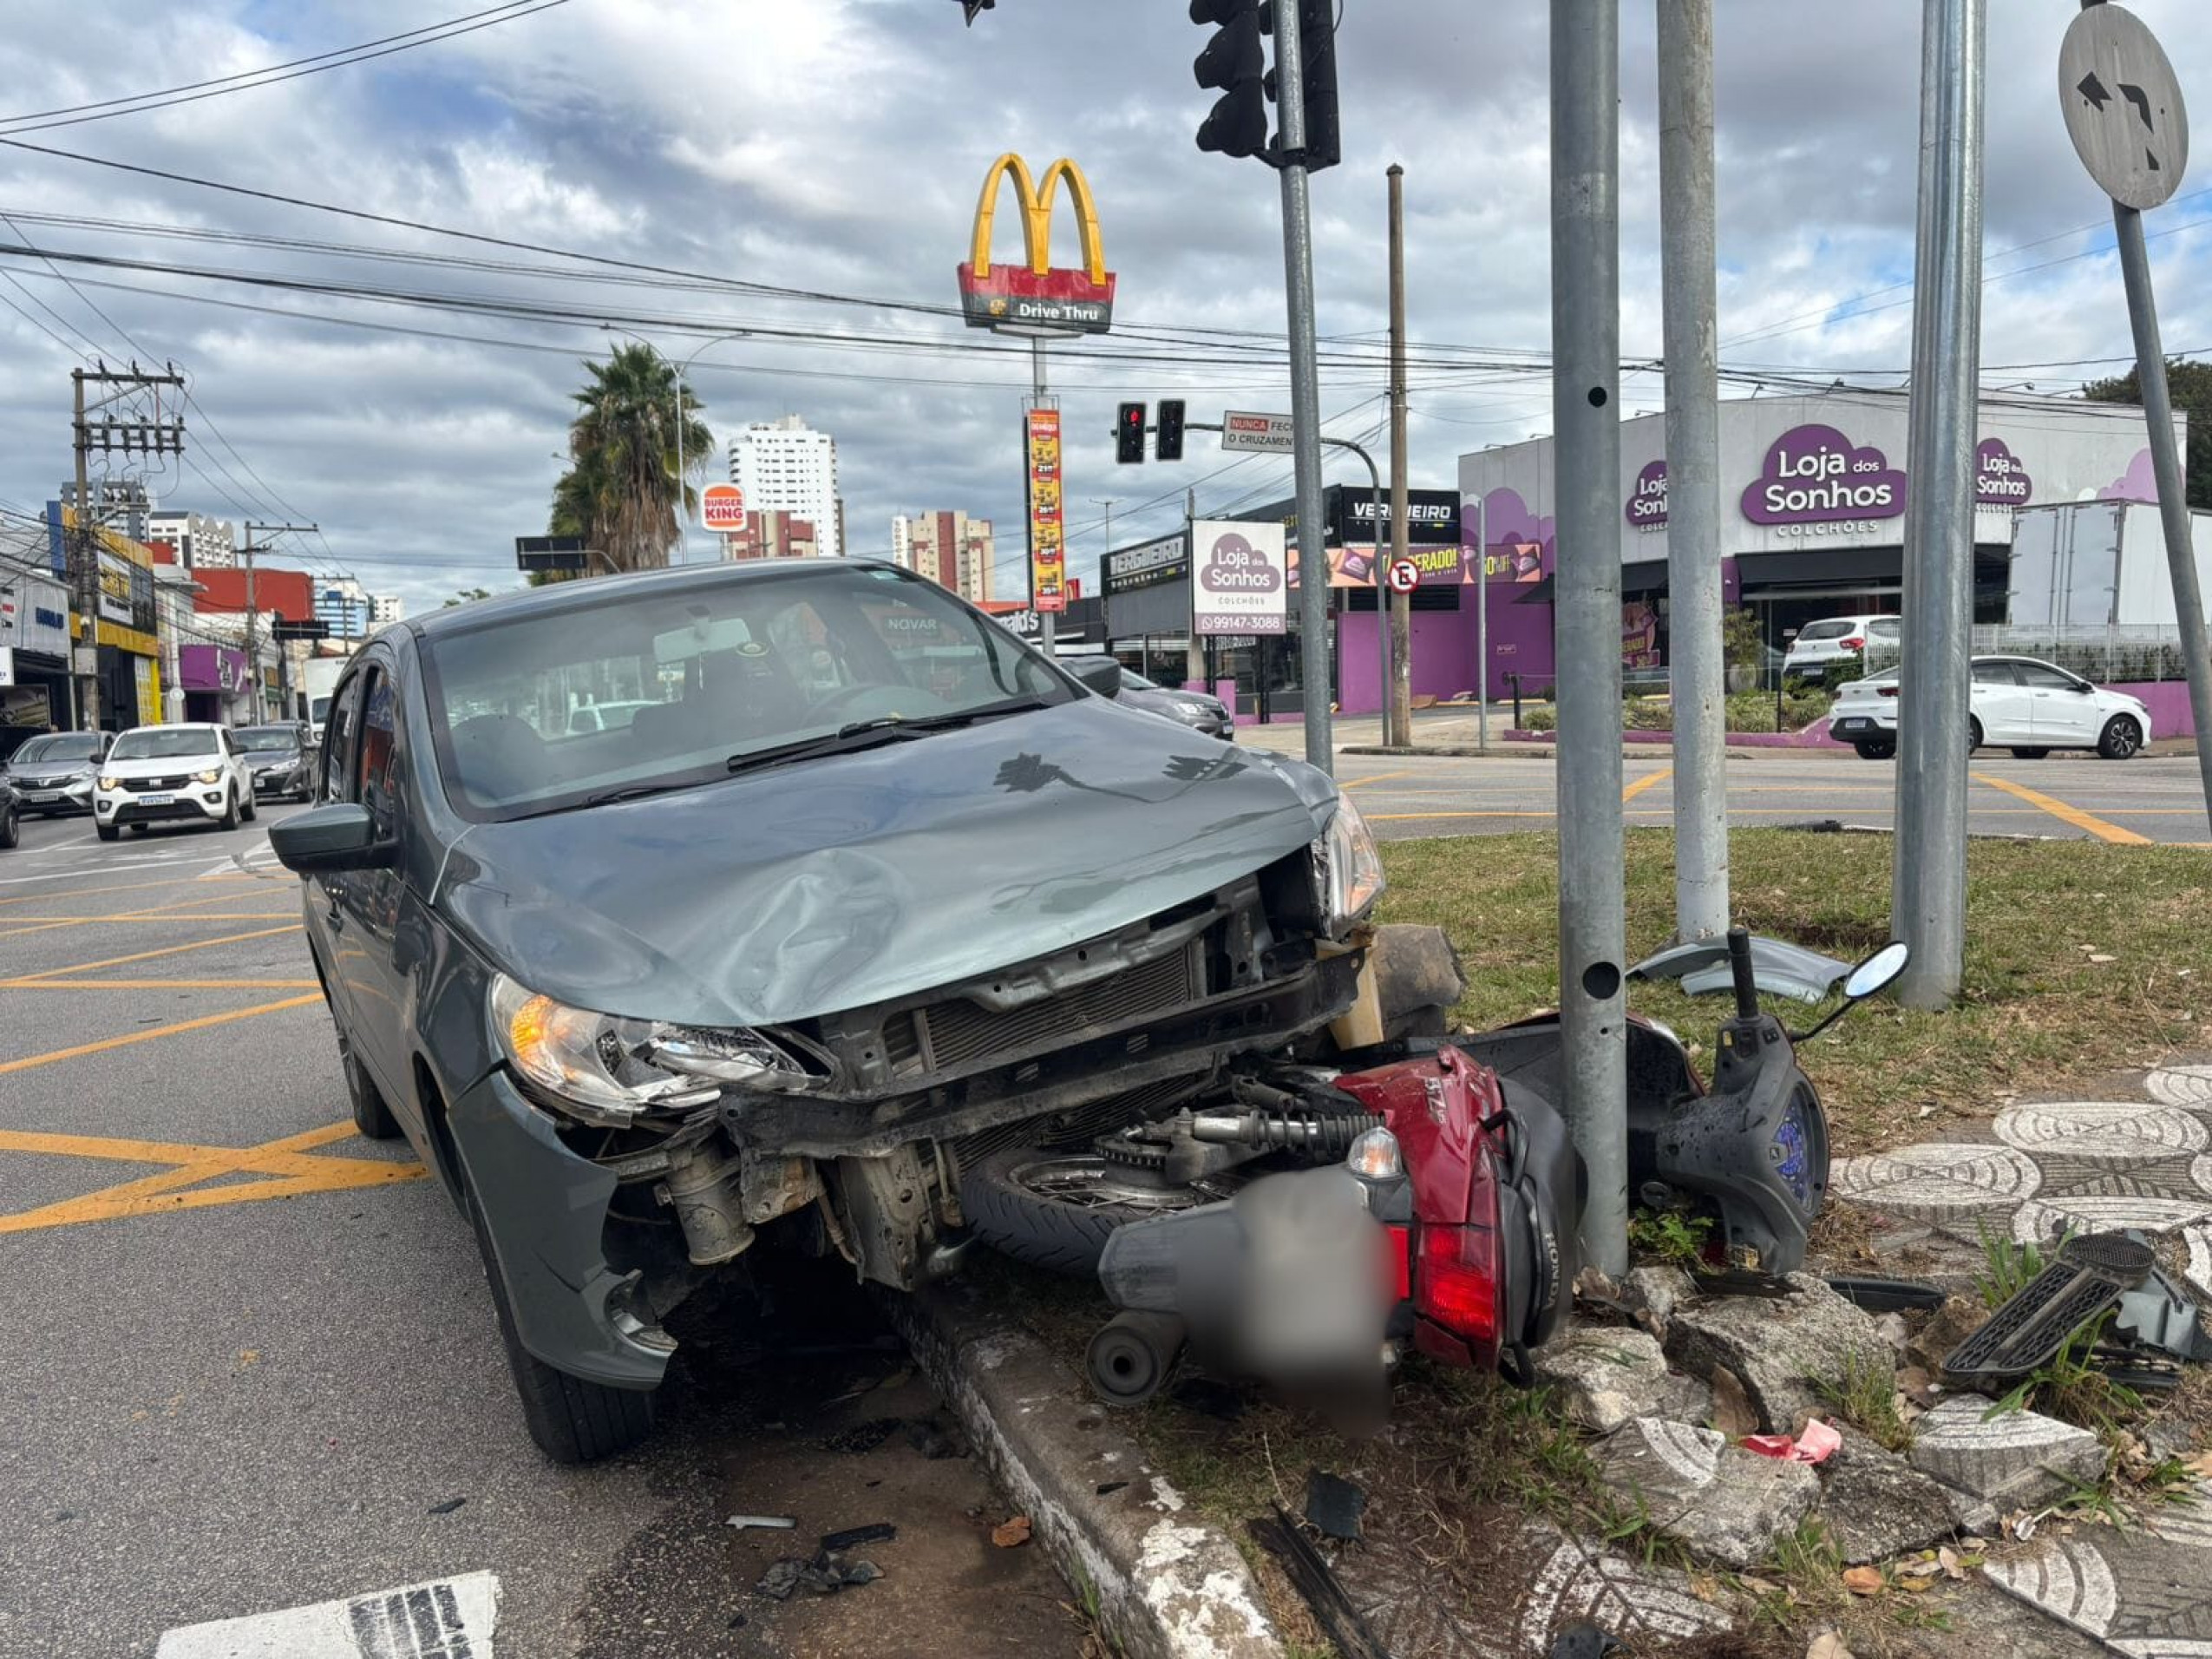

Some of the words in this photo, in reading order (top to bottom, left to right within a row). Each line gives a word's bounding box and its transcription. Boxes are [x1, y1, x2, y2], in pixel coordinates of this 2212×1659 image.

[1019, 304, 1060, 318] Drive
[1063, 306, 1098, 320] Thru
[1232, 418, 1267, 430] NUNCA
[1228, 434, 1237, 443] O
[1239, 435, 1293, 445] CRUZAMEN
[1779, 446, 1846, 482] Loja
[1853, 460, 1880, 473] dos
[1983, 453, 2010, 476] Loja
[1977, 475, 2026, 495] Sonhos
[1765, 480, 1892, 512] Sonhos
[705, 508, 743, 519] KING
[1778, 521, 1880, 536] COLCHÕES
[1217, 548, 1249, 568] Loja
[1211, 568, 1271, 587] Sonhos
[1399, 566, 1410, 586] E
[1542, 1232, 1560, 1311] HONDA
